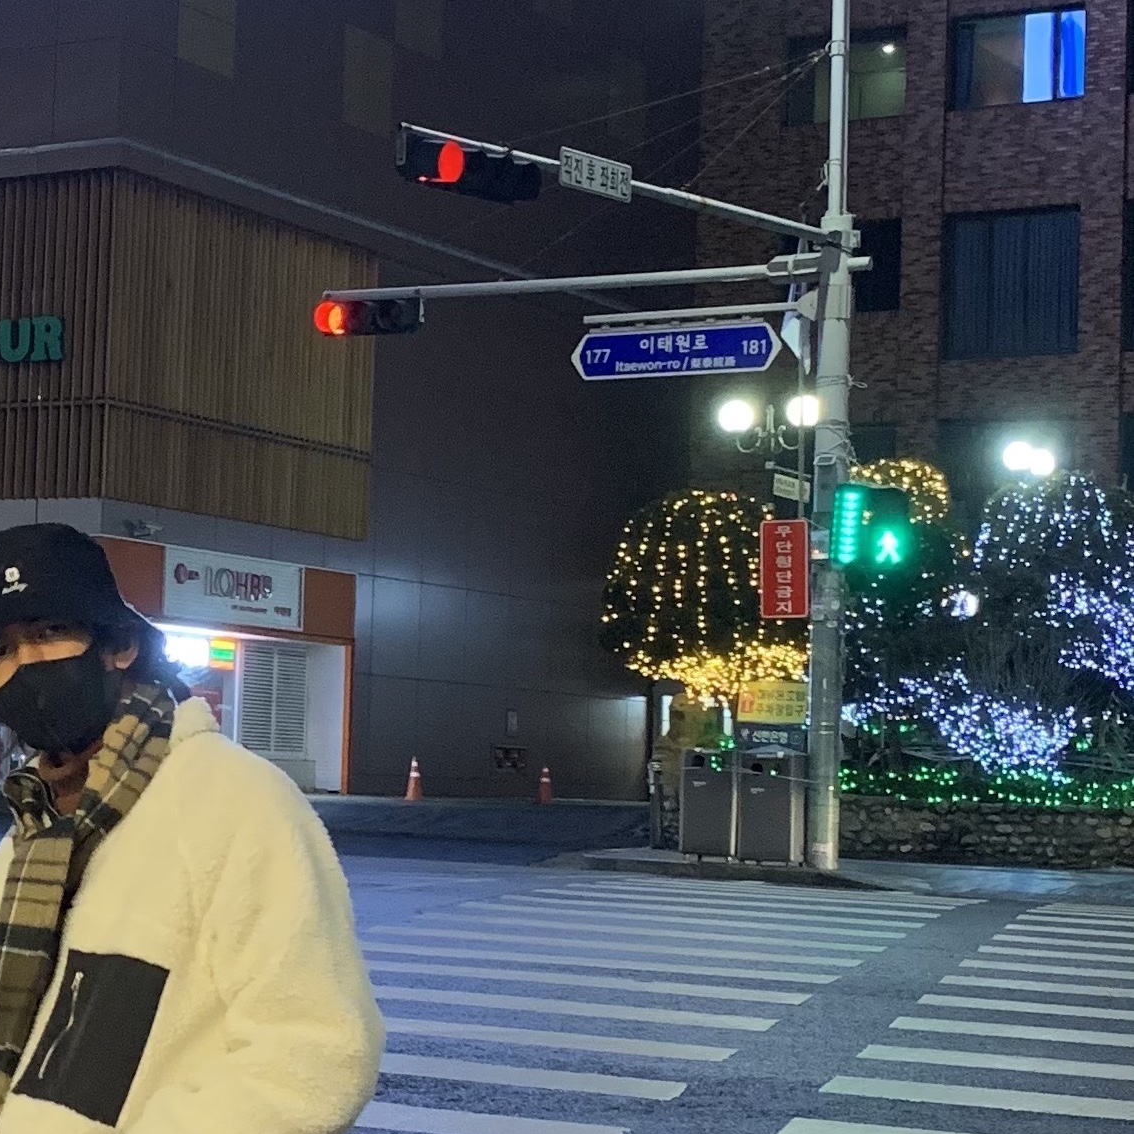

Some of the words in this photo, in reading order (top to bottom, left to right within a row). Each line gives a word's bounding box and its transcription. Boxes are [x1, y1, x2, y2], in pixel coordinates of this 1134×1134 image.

[639, 334, 709, 354] 이태원로
[741, 339, 767, 355] 181
[585, 348, 611, 365] 177
[615, 357, 681, 373] Itaewon-ro
